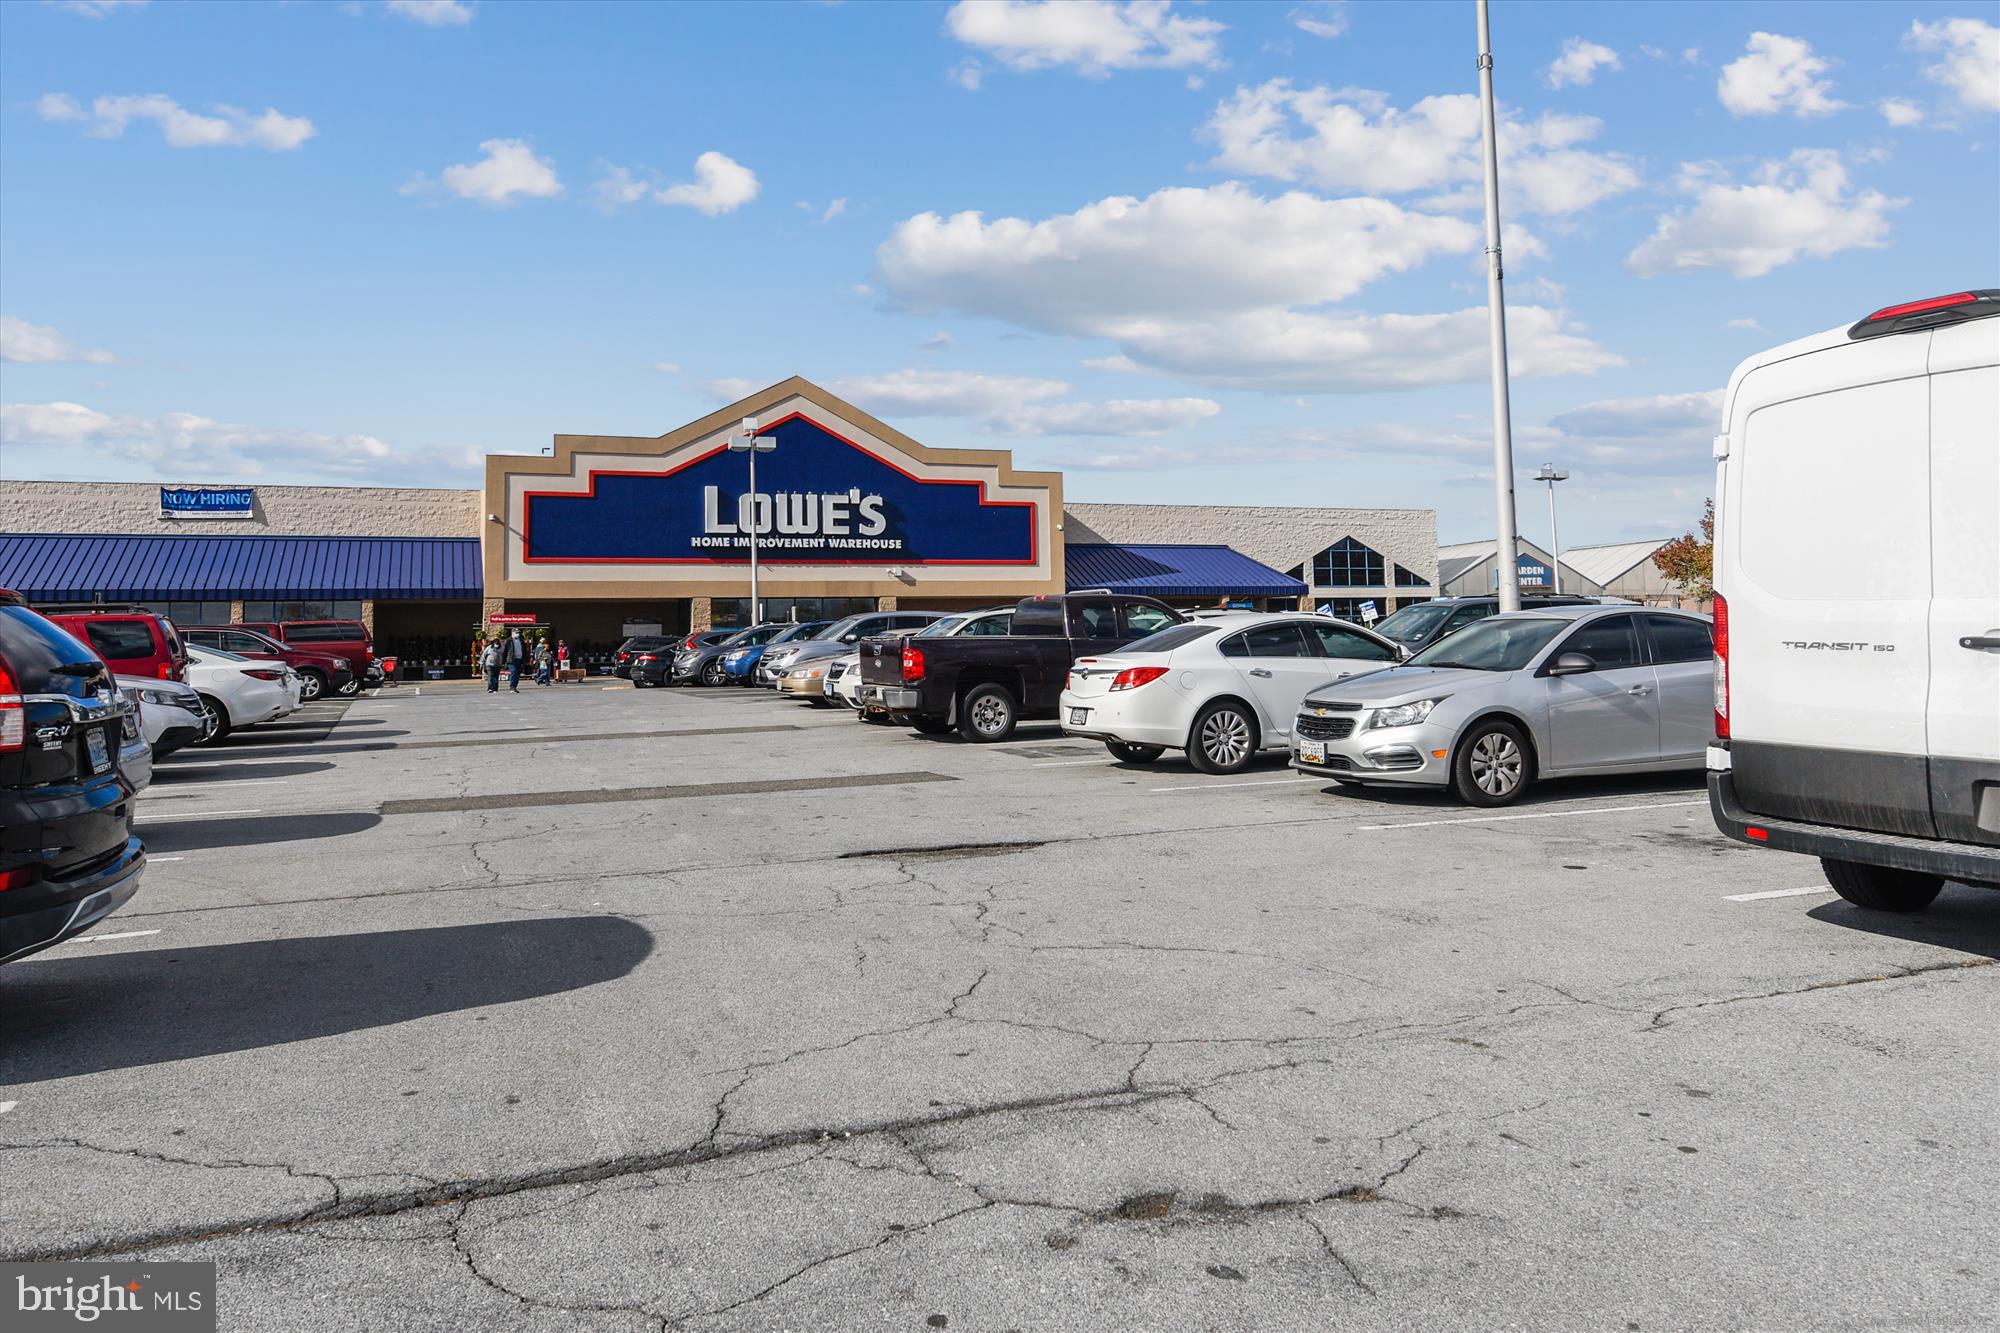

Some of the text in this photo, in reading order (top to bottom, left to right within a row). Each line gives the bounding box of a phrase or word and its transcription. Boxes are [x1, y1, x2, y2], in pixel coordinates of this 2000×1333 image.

[163, 492, 250, 505] NOW HIRING
[704, 486, 887, 536] LOWE'S
[691, 537, 730, 547] HOME
[828, 539, 902, 549] WAREHOUSE
[1518, 566, 1544, 575] ARDEN
[1782, 641, 1869, 651] TRANSIT
